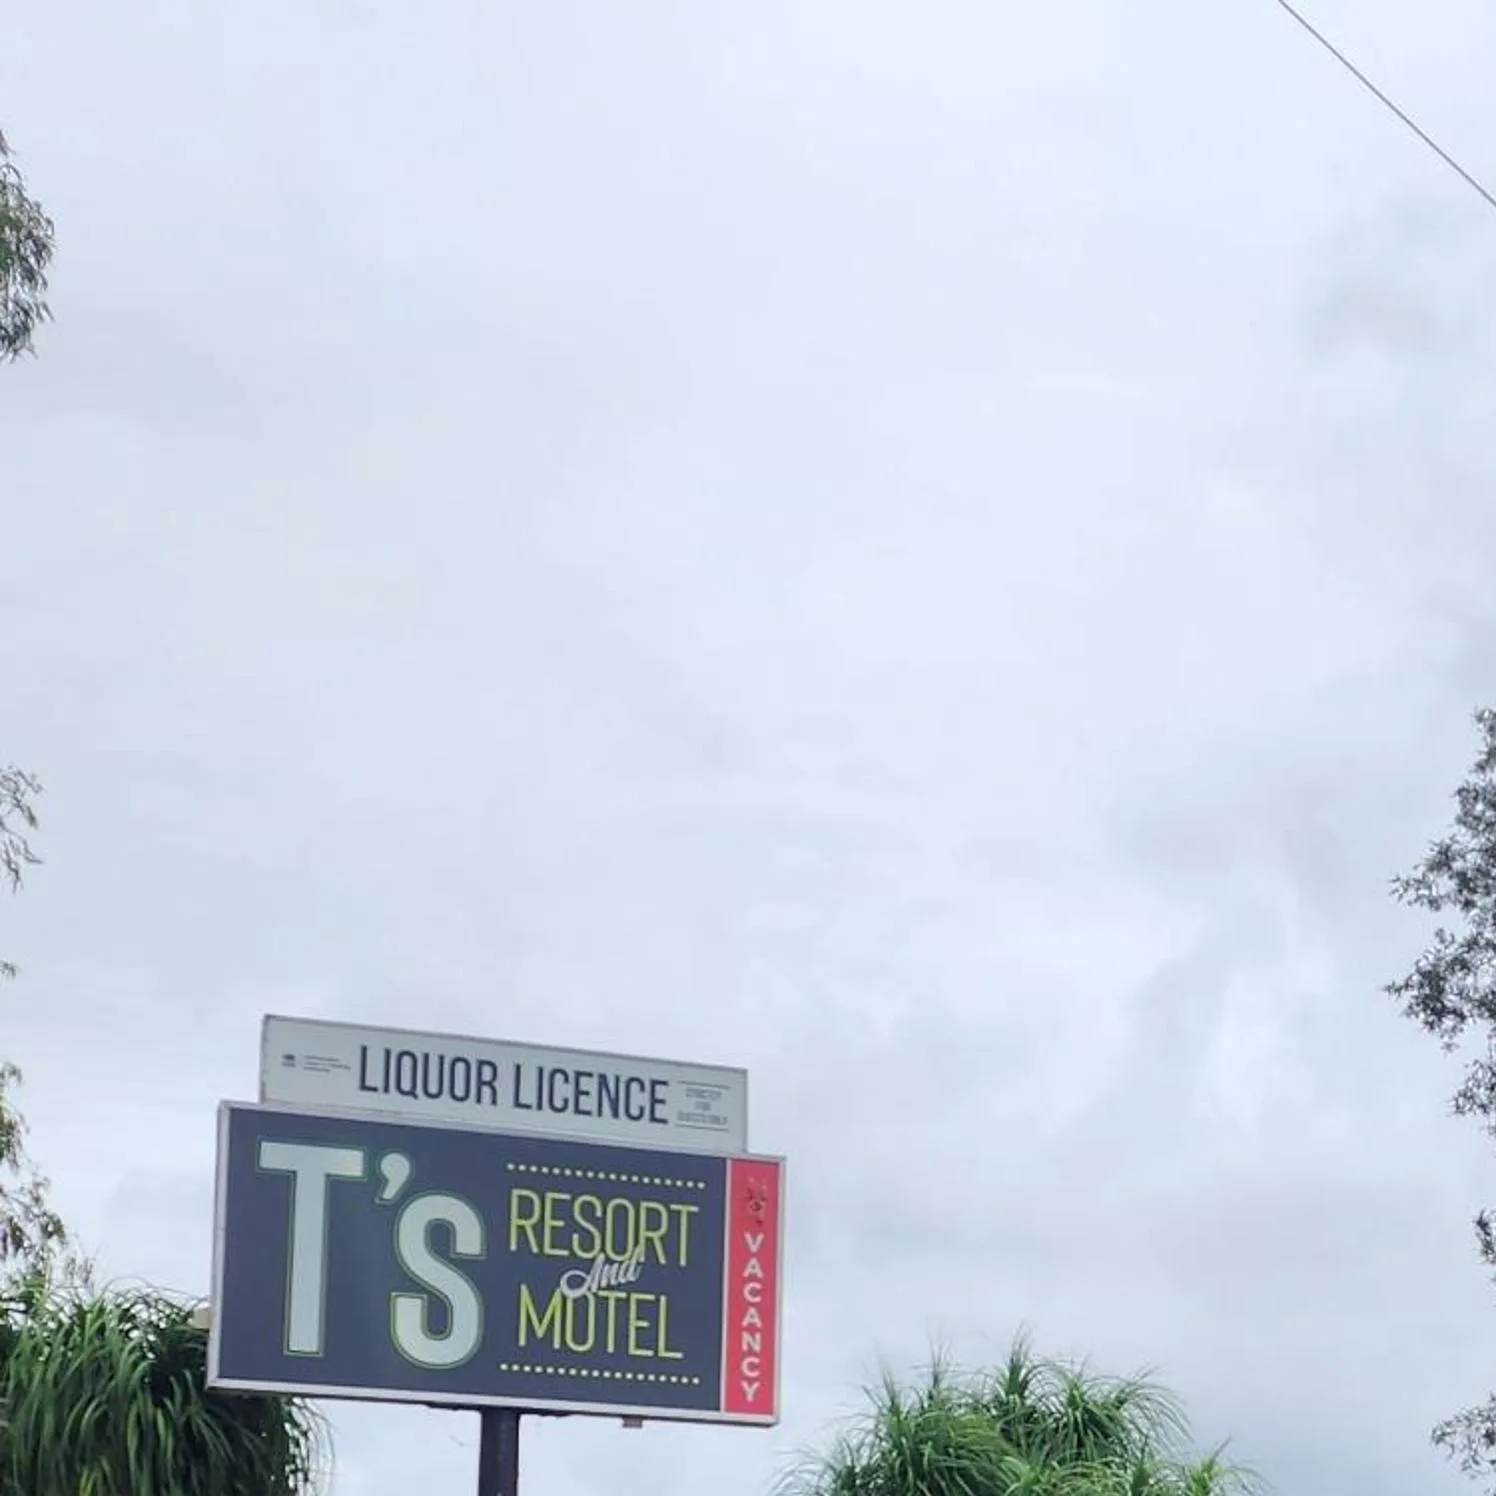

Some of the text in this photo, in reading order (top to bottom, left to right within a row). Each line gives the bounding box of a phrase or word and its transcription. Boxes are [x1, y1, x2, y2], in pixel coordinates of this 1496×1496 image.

[358, 1045, 669, 1125] LIQUOR LICENCE
[509, 1187, 700, 1267] RESORT
[559, 1242, 643, 1300] And
[518, 1283, 684, 1360] MOTEL
[740, 1232, 766, 1403] VACANCY
